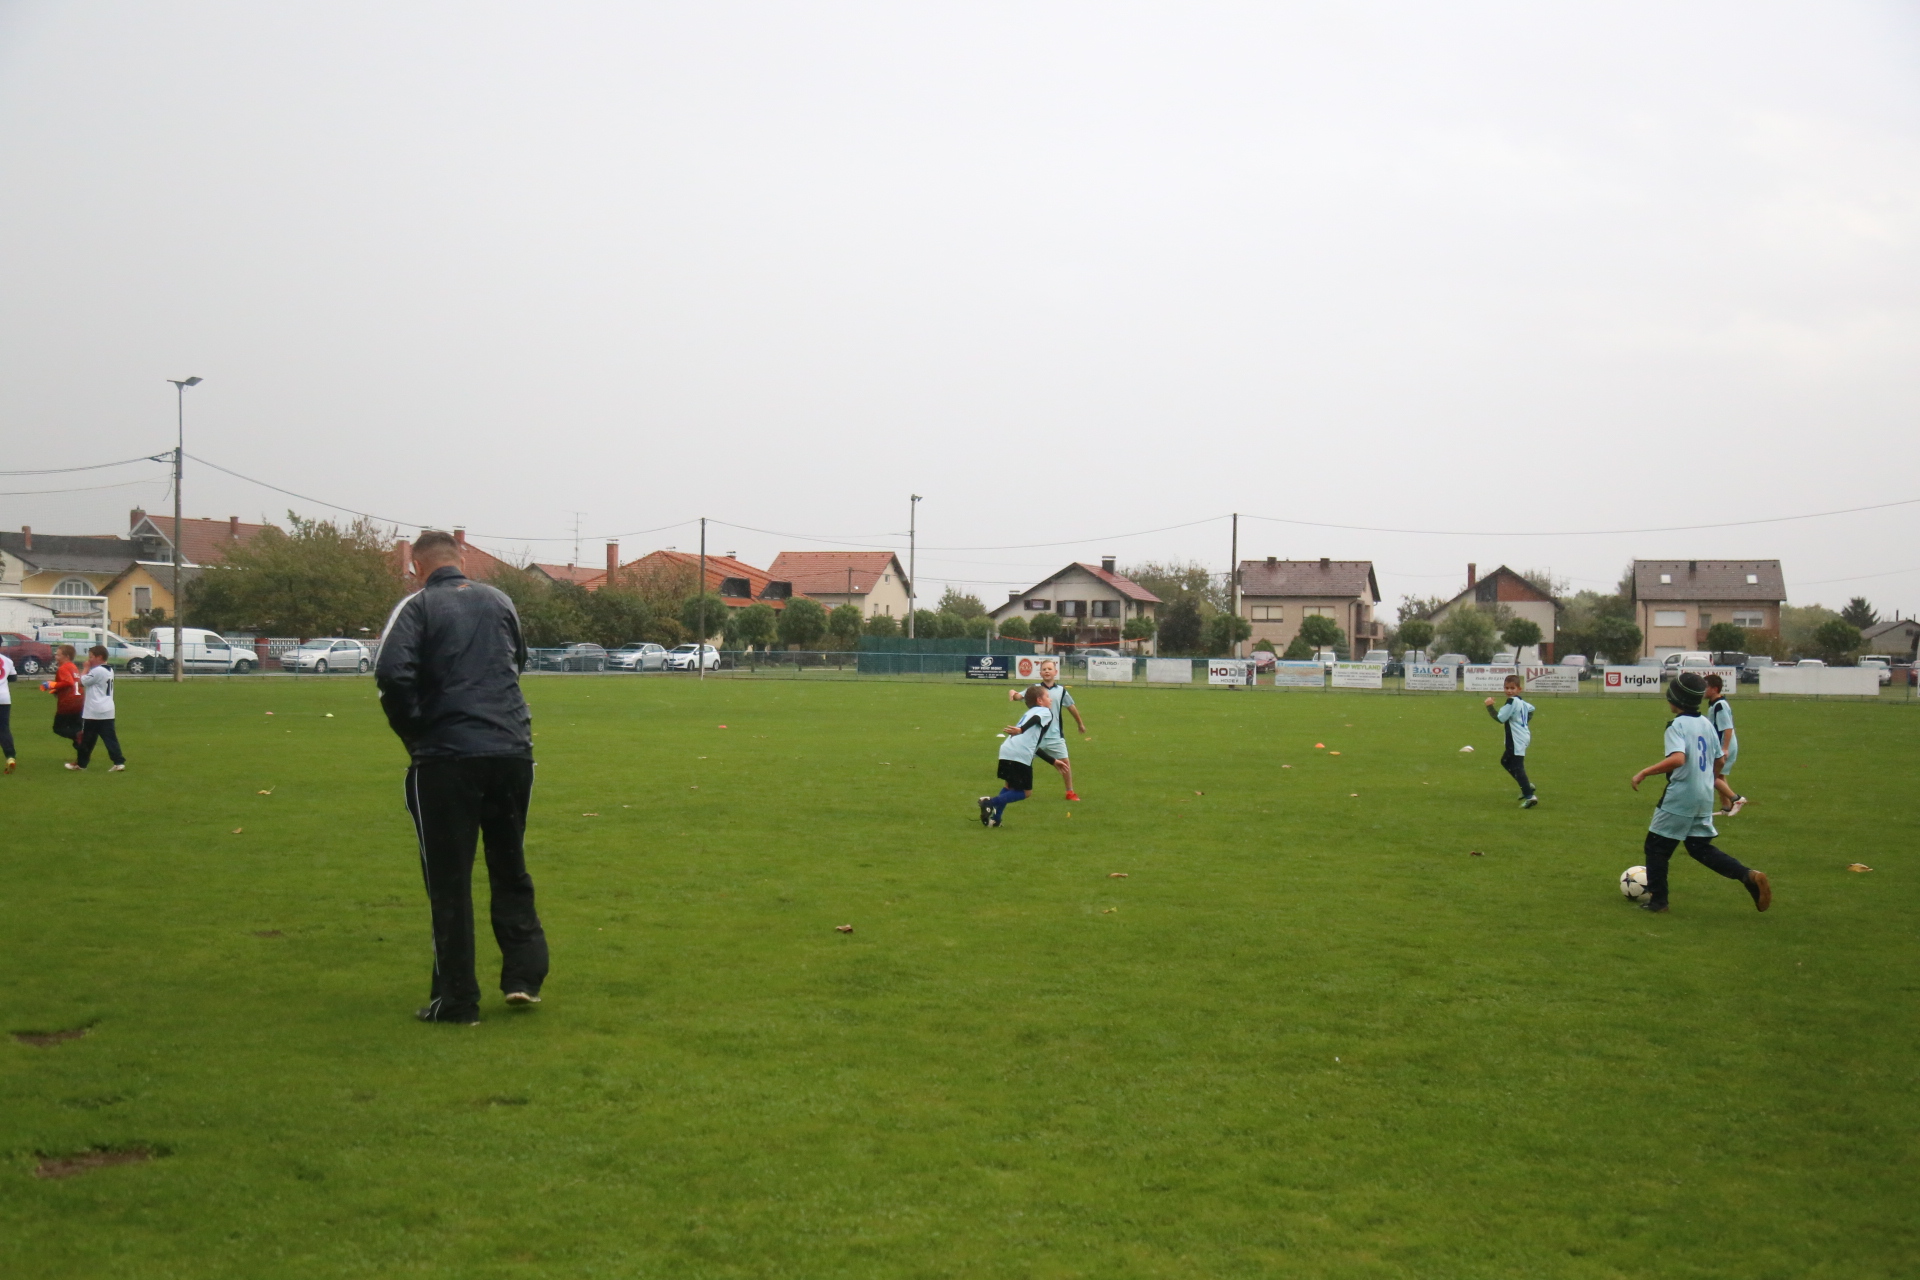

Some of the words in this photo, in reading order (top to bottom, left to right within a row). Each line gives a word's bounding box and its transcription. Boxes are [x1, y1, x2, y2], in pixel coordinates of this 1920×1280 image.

[1210, 668, 1254, 677] HODEX
[1624, 674, 1659, 687] triglav
[1698, 736, 1707, 773] 3
